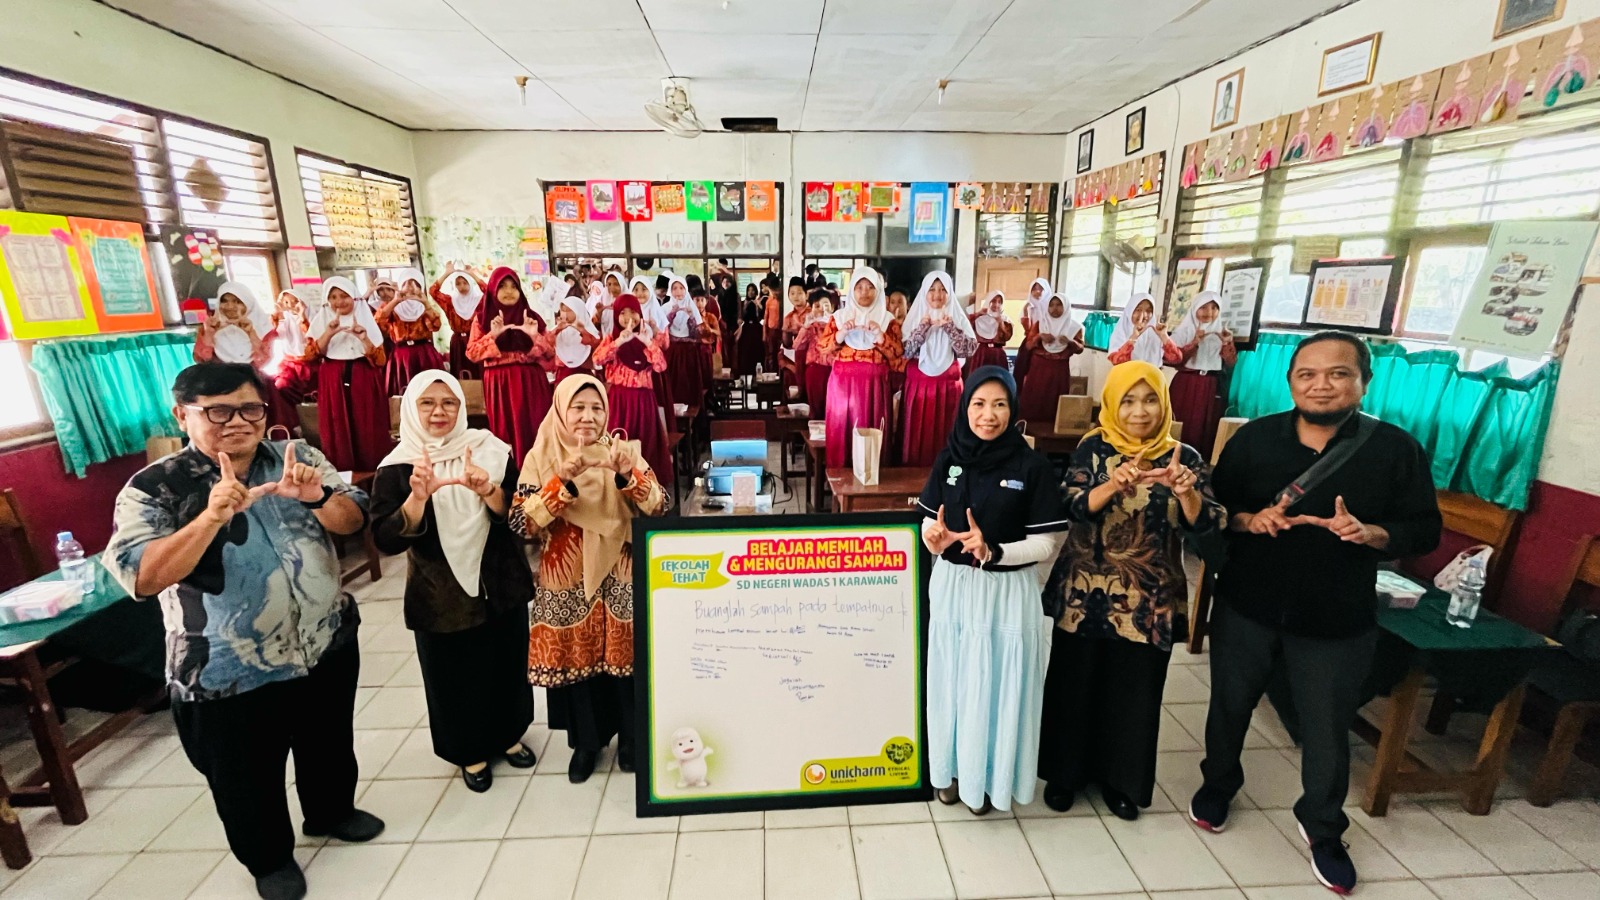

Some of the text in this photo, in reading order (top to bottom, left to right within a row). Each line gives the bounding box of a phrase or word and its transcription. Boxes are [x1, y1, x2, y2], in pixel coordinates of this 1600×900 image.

[750, 539, 883, 556] BELAJAR MEMILAH
[661, 560, 710, 572] SEKOLAH
[729, 554, 903, 572] & MENGURANGI SAMPAH
[672, 572, 706, 583] SEHAT
[736, 575, 898, 590] SD NEGERI WADAS 1 KARAWANG
[798, 596, 827, 621] pada
[832, 594, 893, 621] tempatnya
[830, 765, 886, 780] unicharm
